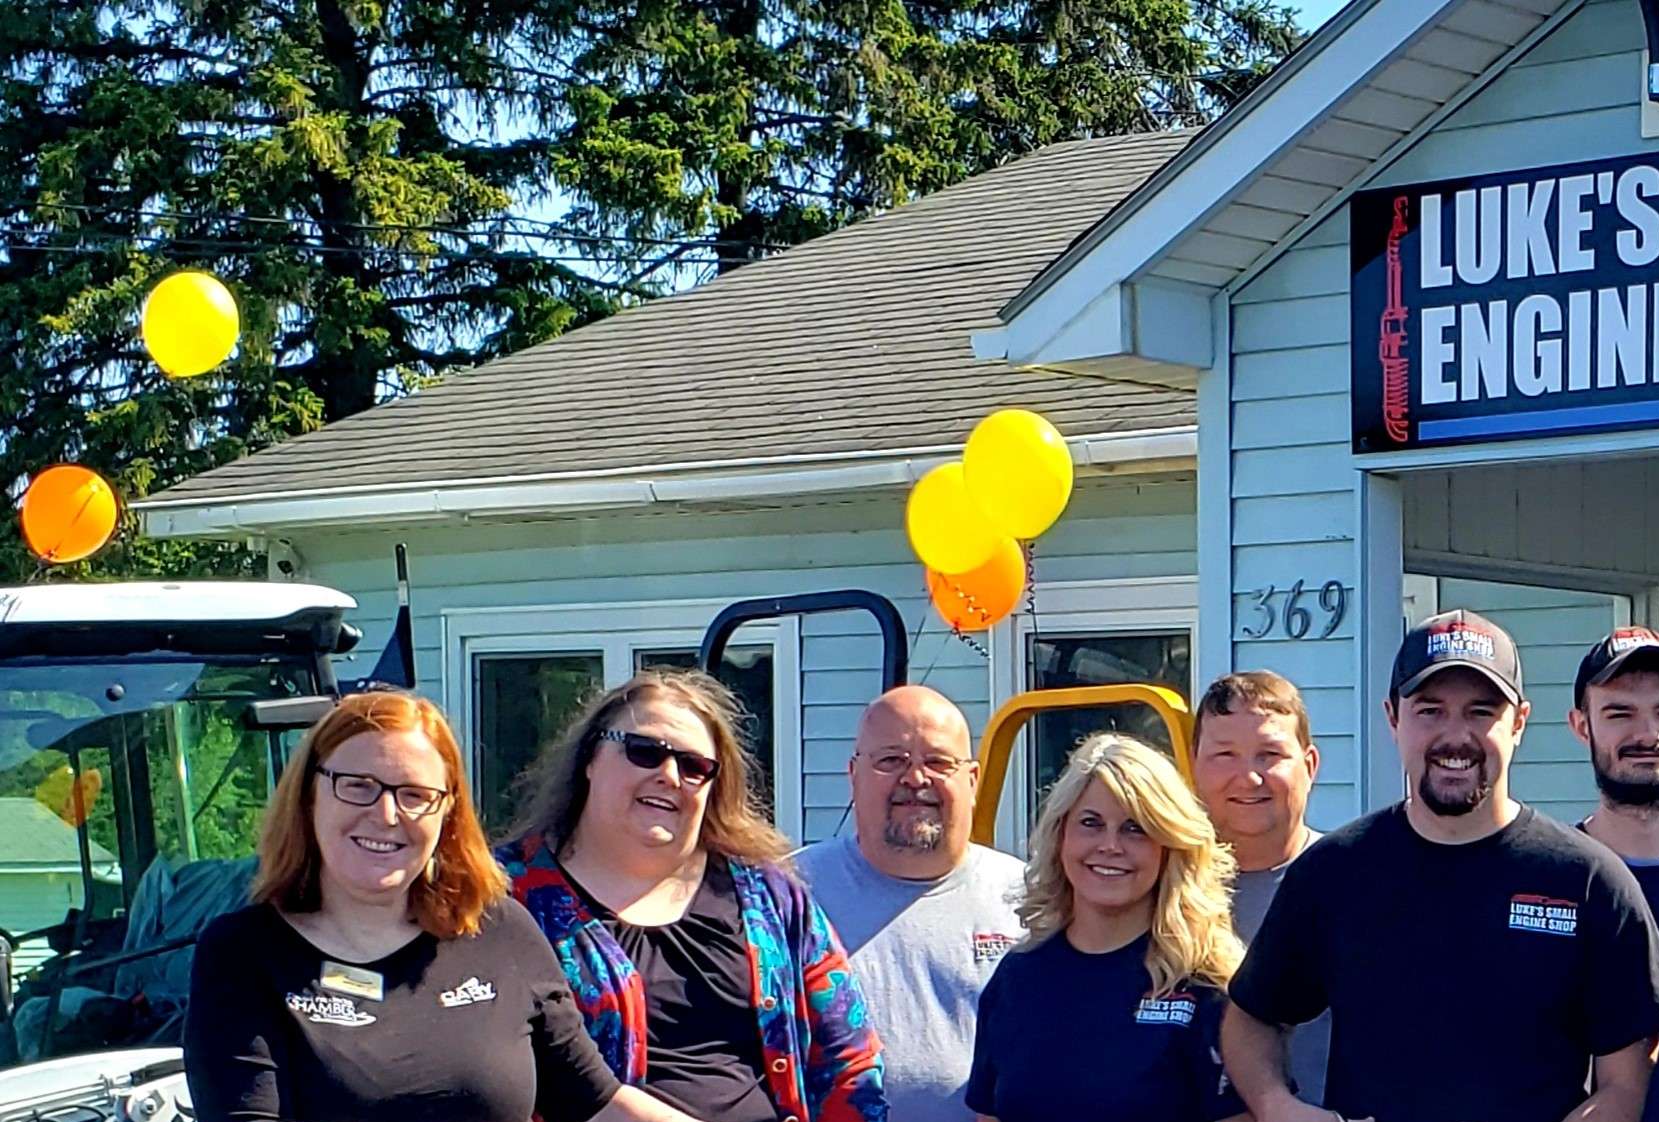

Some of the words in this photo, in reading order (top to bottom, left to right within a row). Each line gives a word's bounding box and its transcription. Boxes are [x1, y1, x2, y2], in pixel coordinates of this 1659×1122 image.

[1243, 579, 1346, 639] 369
[1511, 903, 1544, 917] LUKE'S
[1546, 907, 1577, 920] SMALL
[1509, 914, 1547, 929] ENGINE
[1548, 919, 1577, 932] SHOP
